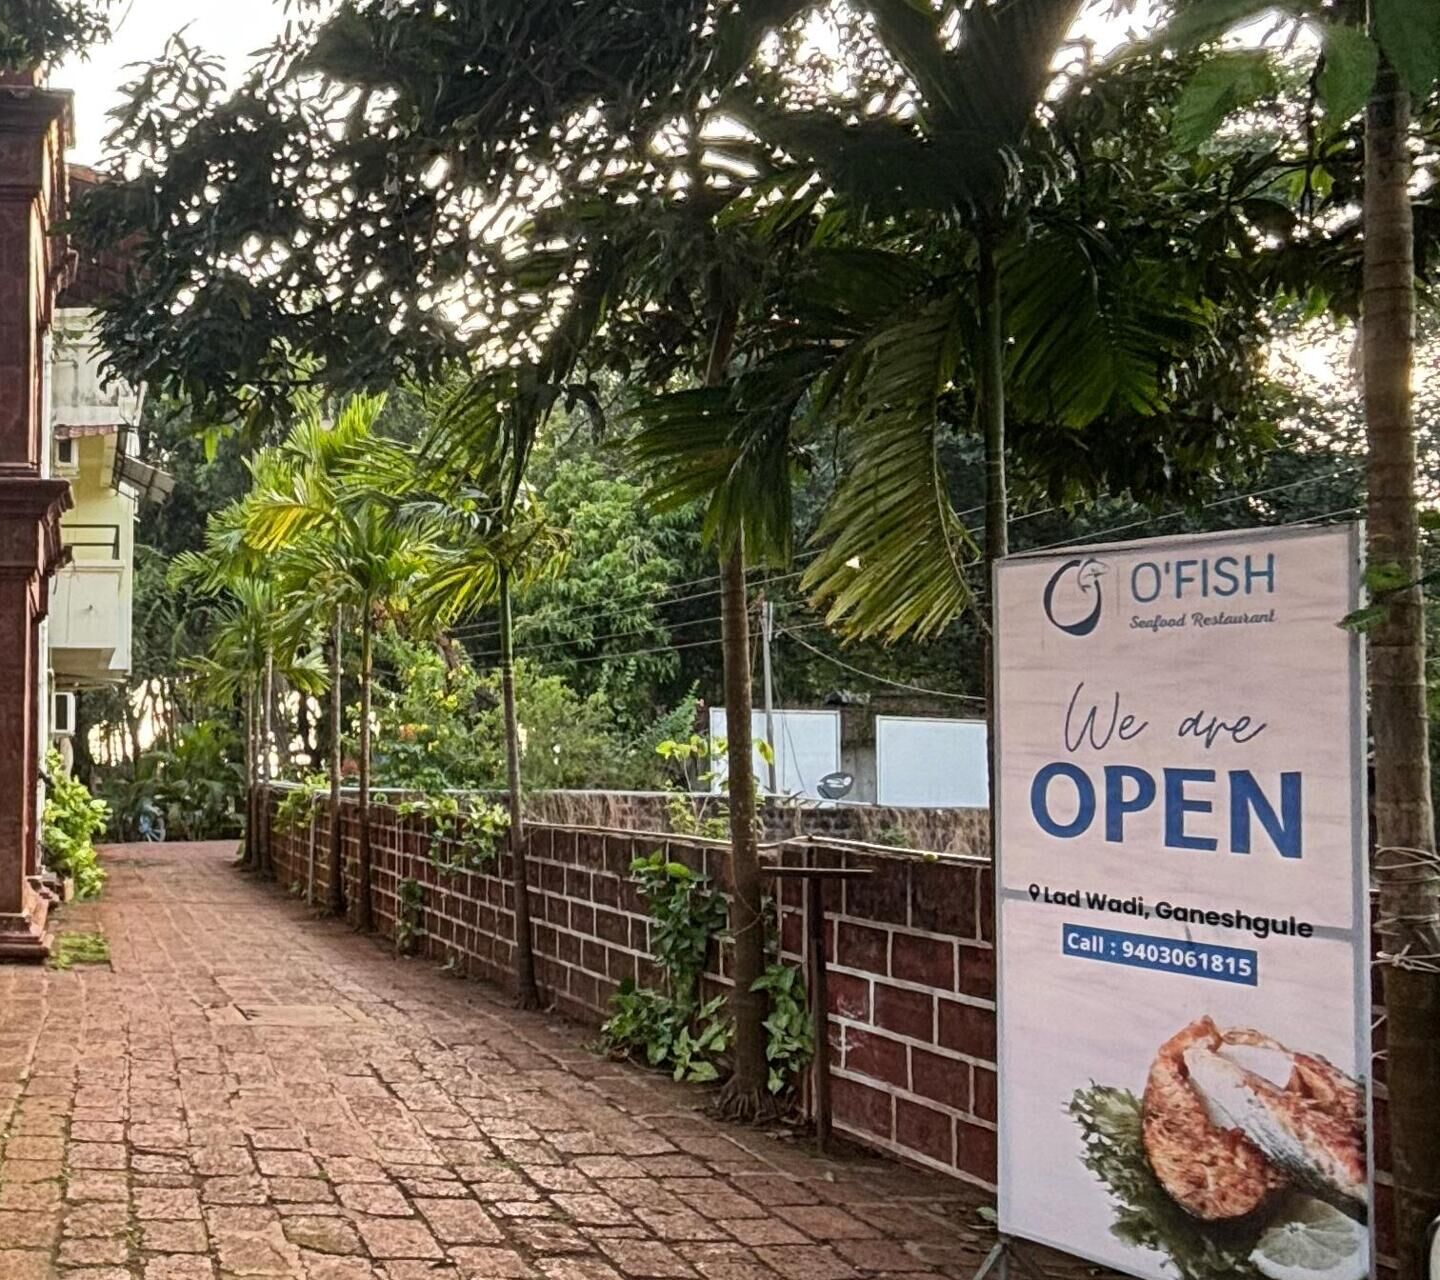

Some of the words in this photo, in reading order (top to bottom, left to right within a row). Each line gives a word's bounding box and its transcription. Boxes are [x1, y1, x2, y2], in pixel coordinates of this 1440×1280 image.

[1131, 553, 1274, 603] O'FISH
[1130, 615, 1186, 632] Seafood
[1192, 609, 1275, 627] Restaurant
[1064, 681, 1149, 752] We
[1177, 710, 1268, 749] are
[1030, 761, 1303, 859] OPEN
[1044, 886, 1081, 908] Lad
[1085, 891, 1150, 920] Wadi,
[1155, 901, 1314, 939] Ganeshgule
[1067, 933, 1104, 953] Call
[1122, 941, 1252, 977] 9403061815
